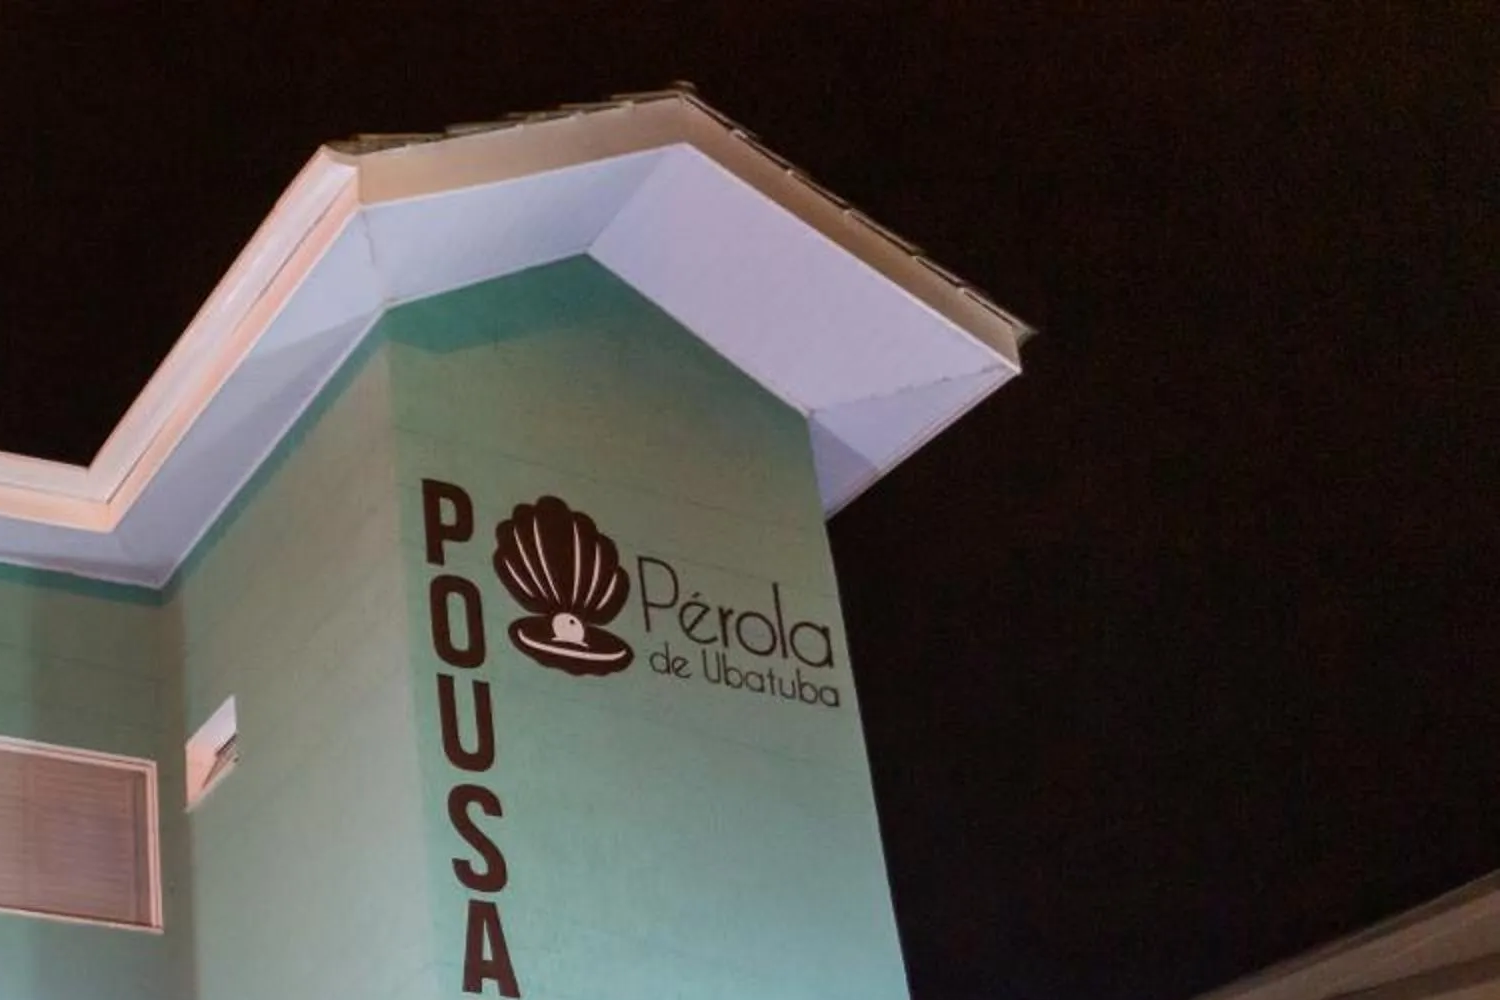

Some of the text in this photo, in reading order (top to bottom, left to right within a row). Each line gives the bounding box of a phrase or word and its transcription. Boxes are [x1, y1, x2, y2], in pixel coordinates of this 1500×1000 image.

[637, 556, 834, 668] Pérola
[650, 641, 840, 708] de Ubatuba
